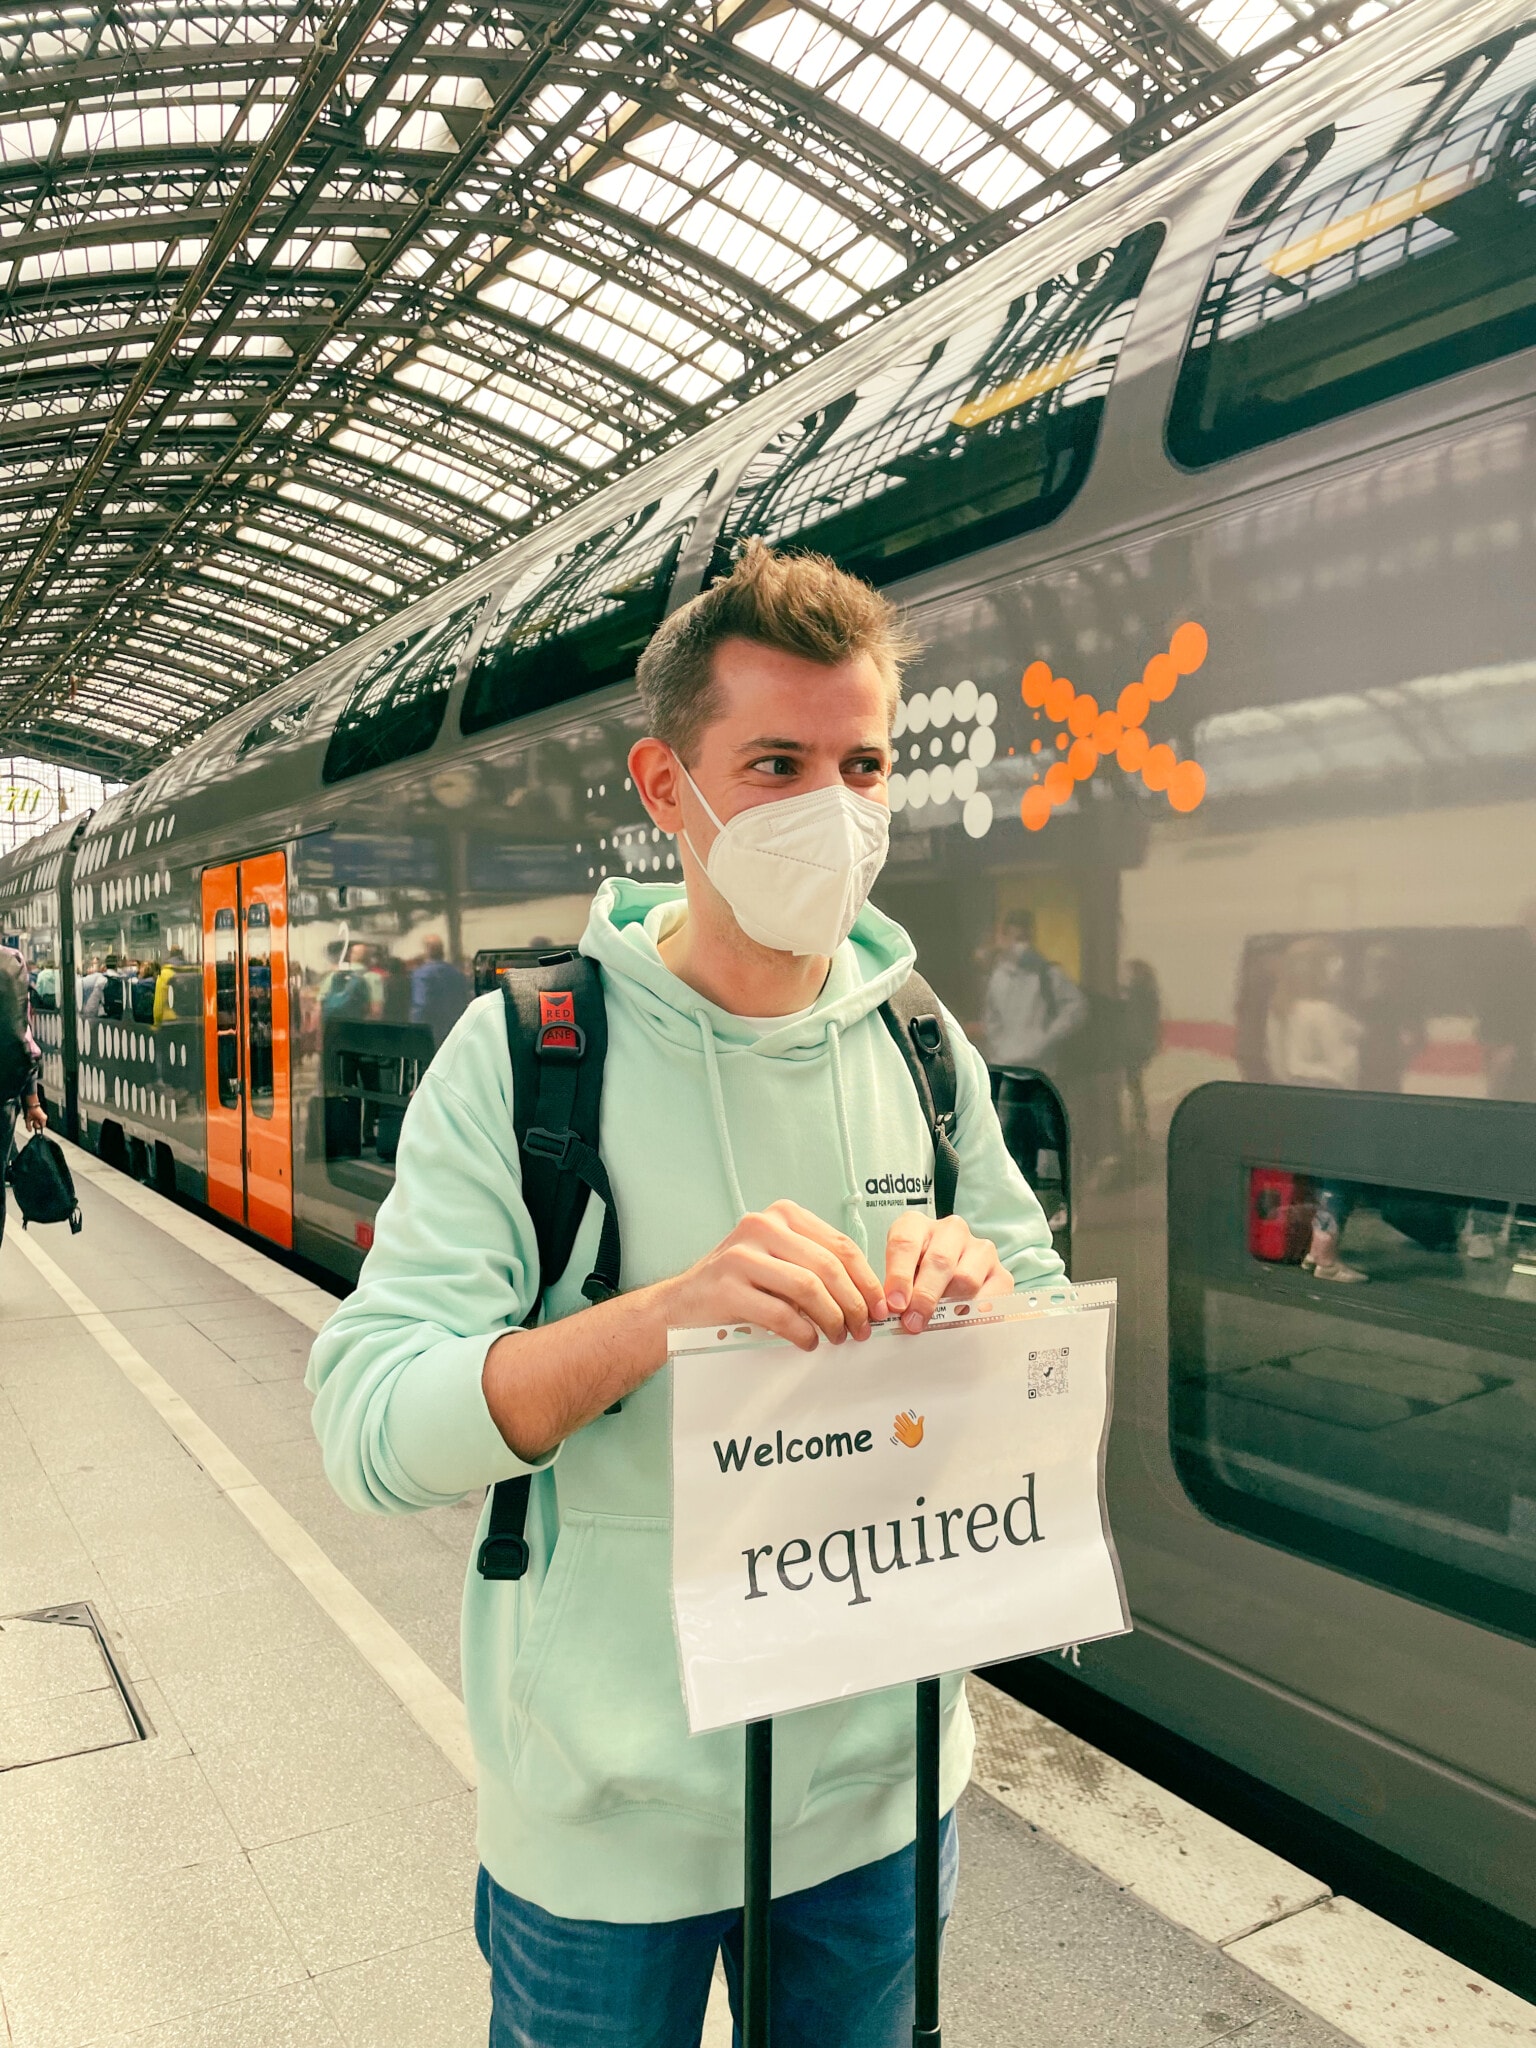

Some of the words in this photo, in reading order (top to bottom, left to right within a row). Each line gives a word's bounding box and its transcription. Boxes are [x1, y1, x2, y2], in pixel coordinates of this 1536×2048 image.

[0, 786, 41, 814] 711
[546, 1009, 571, 1018] RED
[546, 1030, 571, 1039] ANE
[865, 1173, 921, 1193] adidas
[713, 1429, 873, 1473] Welcome
[741, 1472, 1046, 1607] required
